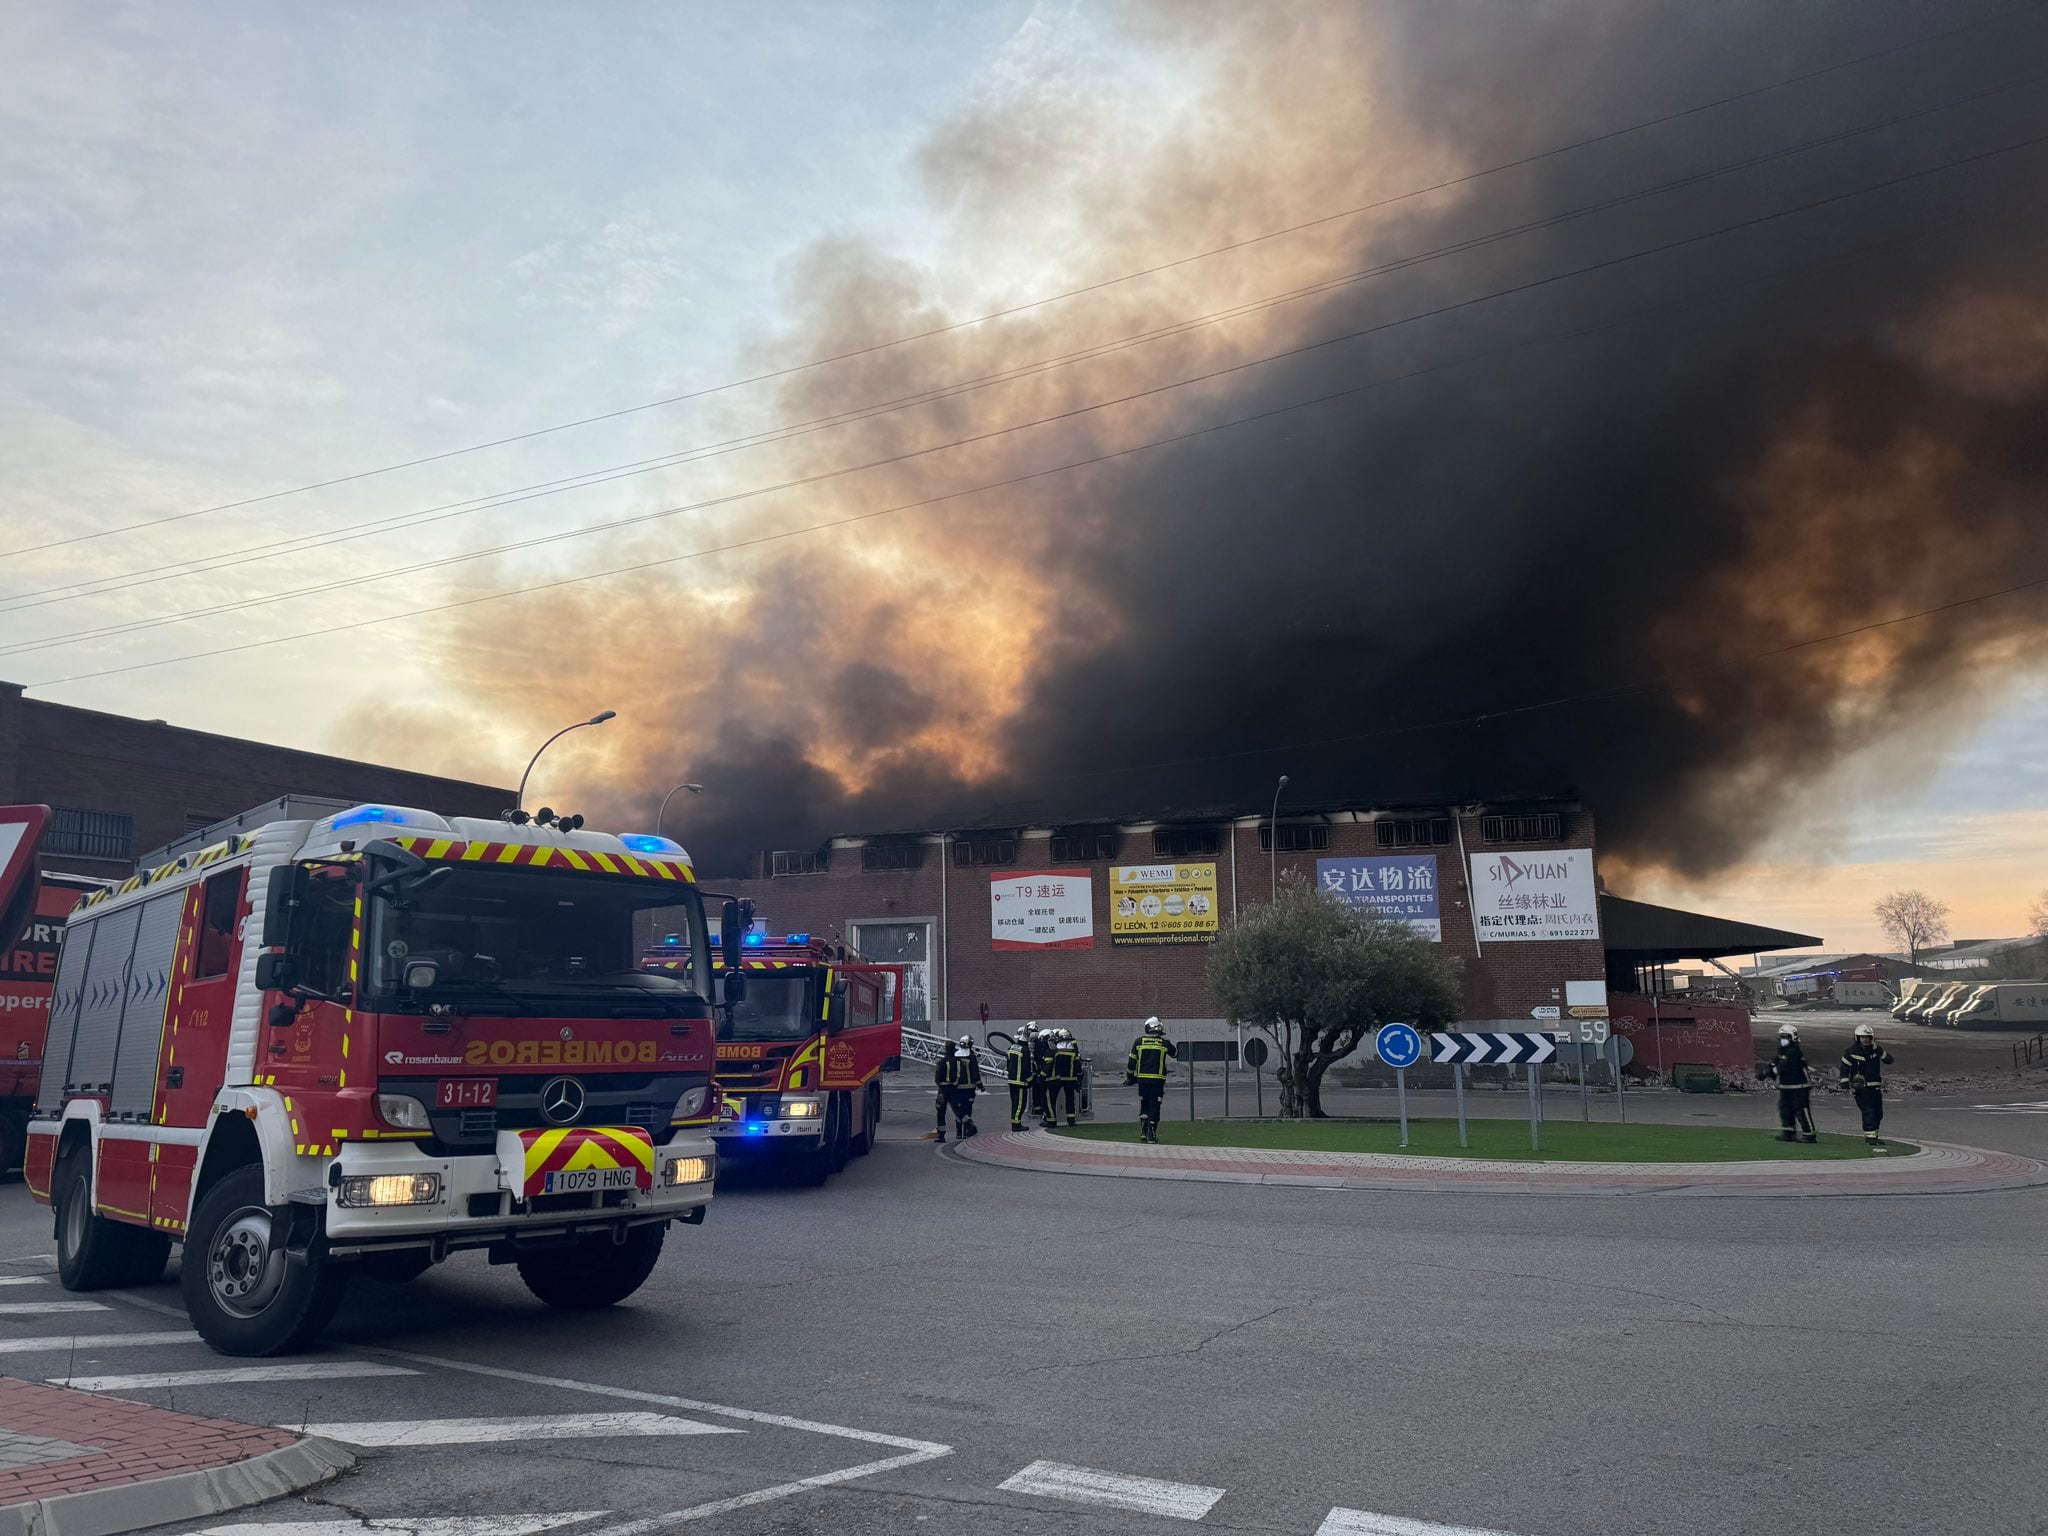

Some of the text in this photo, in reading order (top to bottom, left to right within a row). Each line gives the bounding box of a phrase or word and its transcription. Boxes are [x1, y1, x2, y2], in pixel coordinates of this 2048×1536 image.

[1322, 866, 1433, 892] 安达物流
[1016, 884, 1065, 898] T9 速运
[1498, 893, 1567, 910] 丝缘袜业
[1580, 1021, 1607, 1044] 59
[405, 1053, 463, 1065] rosenbauer
[444, 1083, 491, 1103] 31-12
[559, 1169, 632, 1190] 1079 HNG
